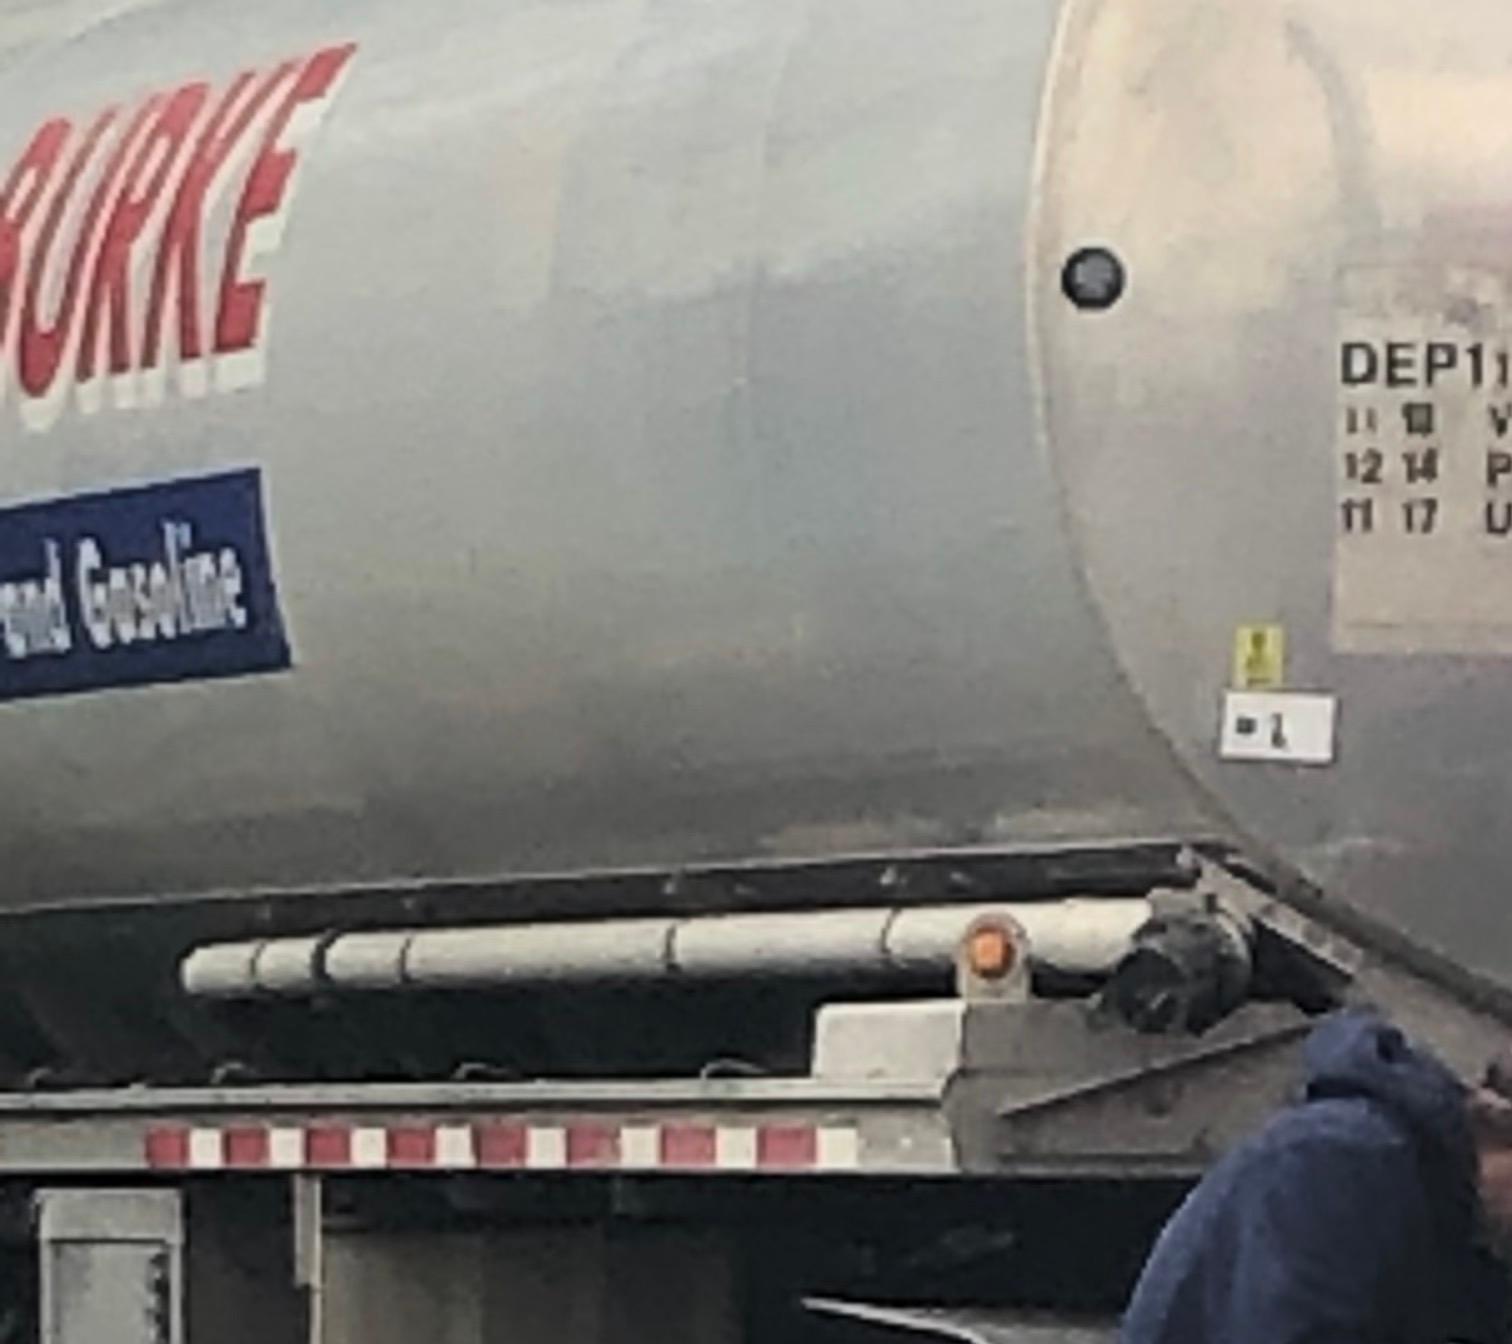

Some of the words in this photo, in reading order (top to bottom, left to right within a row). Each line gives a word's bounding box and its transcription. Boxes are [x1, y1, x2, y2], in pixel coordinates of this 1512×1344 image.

[1345, 449, 1382, 484] 12
[1402, 499, 1438, 533] 17
[77, 520, 247, 648] Gasoline
